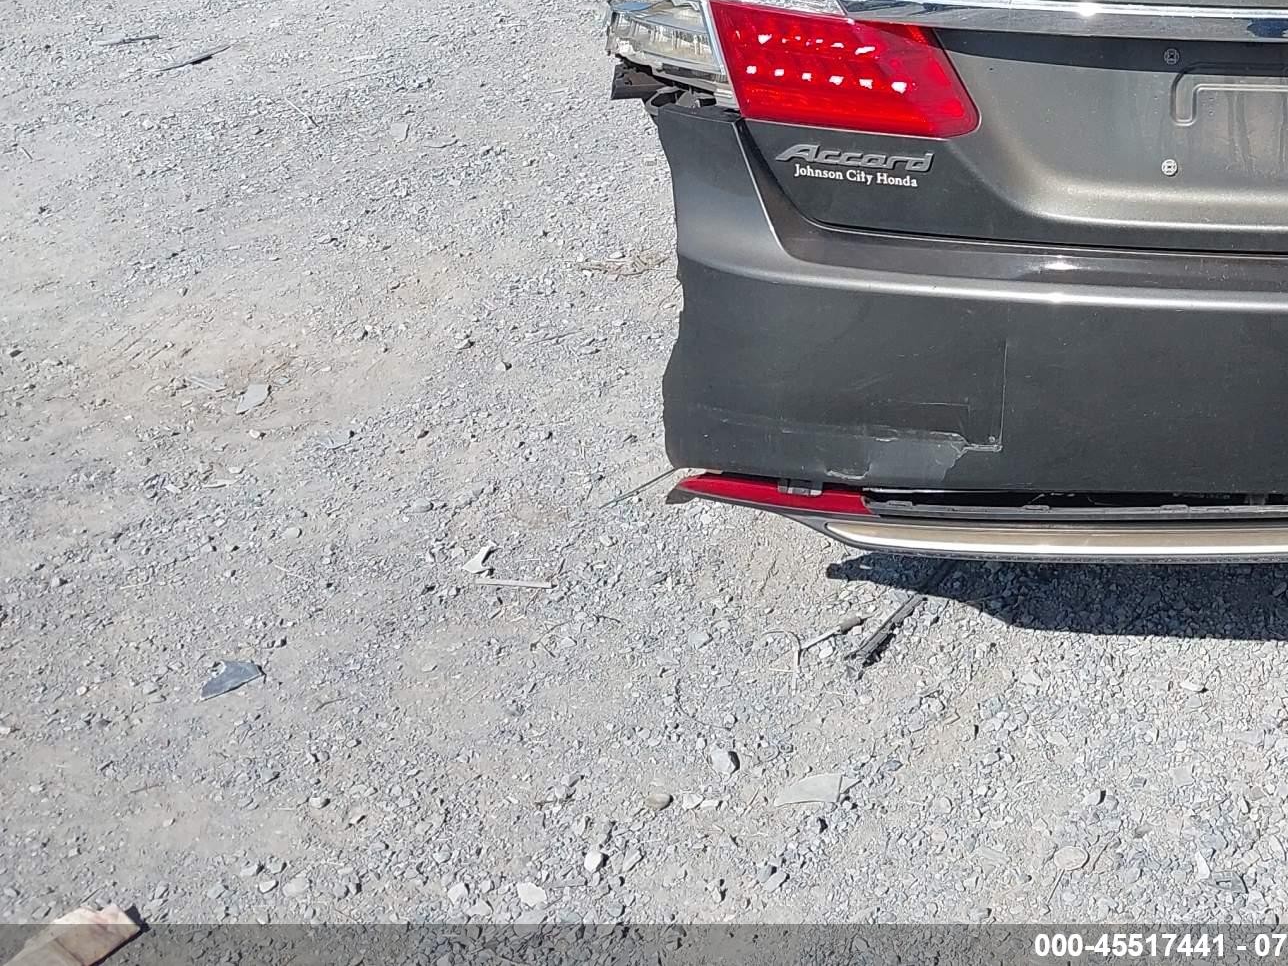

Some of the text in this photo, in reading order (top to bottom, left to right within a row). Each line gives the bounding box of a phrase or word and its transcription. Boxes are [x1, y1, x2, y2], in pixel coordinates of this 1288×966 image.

[775, 143, 935, 172] Accord
[794, 163, 918, 187] Johnson City Honda
